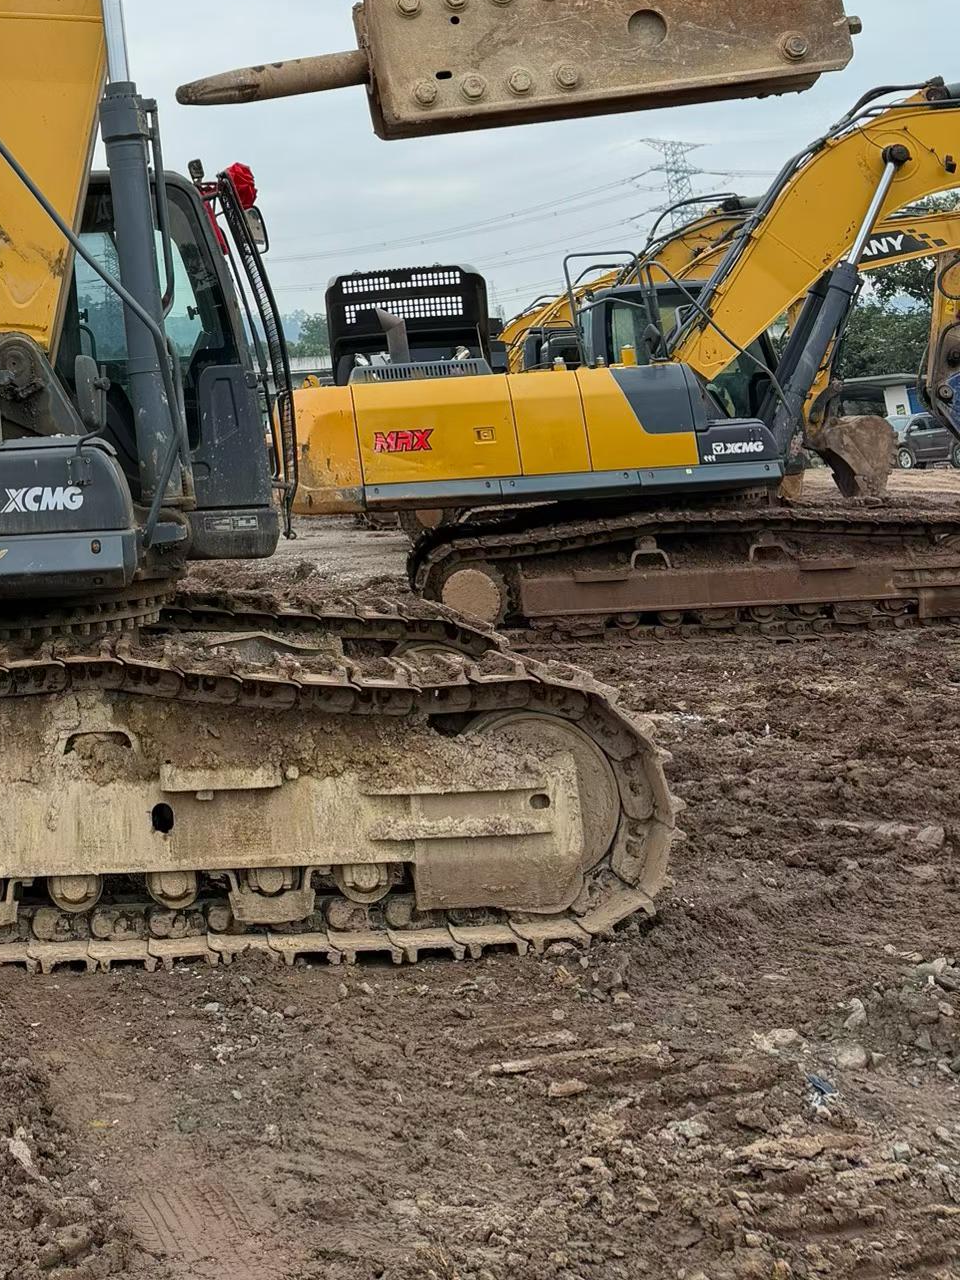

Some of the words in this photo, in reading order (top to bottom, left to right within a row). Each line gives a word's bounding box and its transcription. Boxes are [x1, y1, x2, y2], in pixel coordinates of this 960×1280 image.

[863, 234, 904, 257] ANY
[372, 428, 434, 453] MAX
[725, 441, 764, 454] XCMG
[0, 486, 83, 513] XCMG
